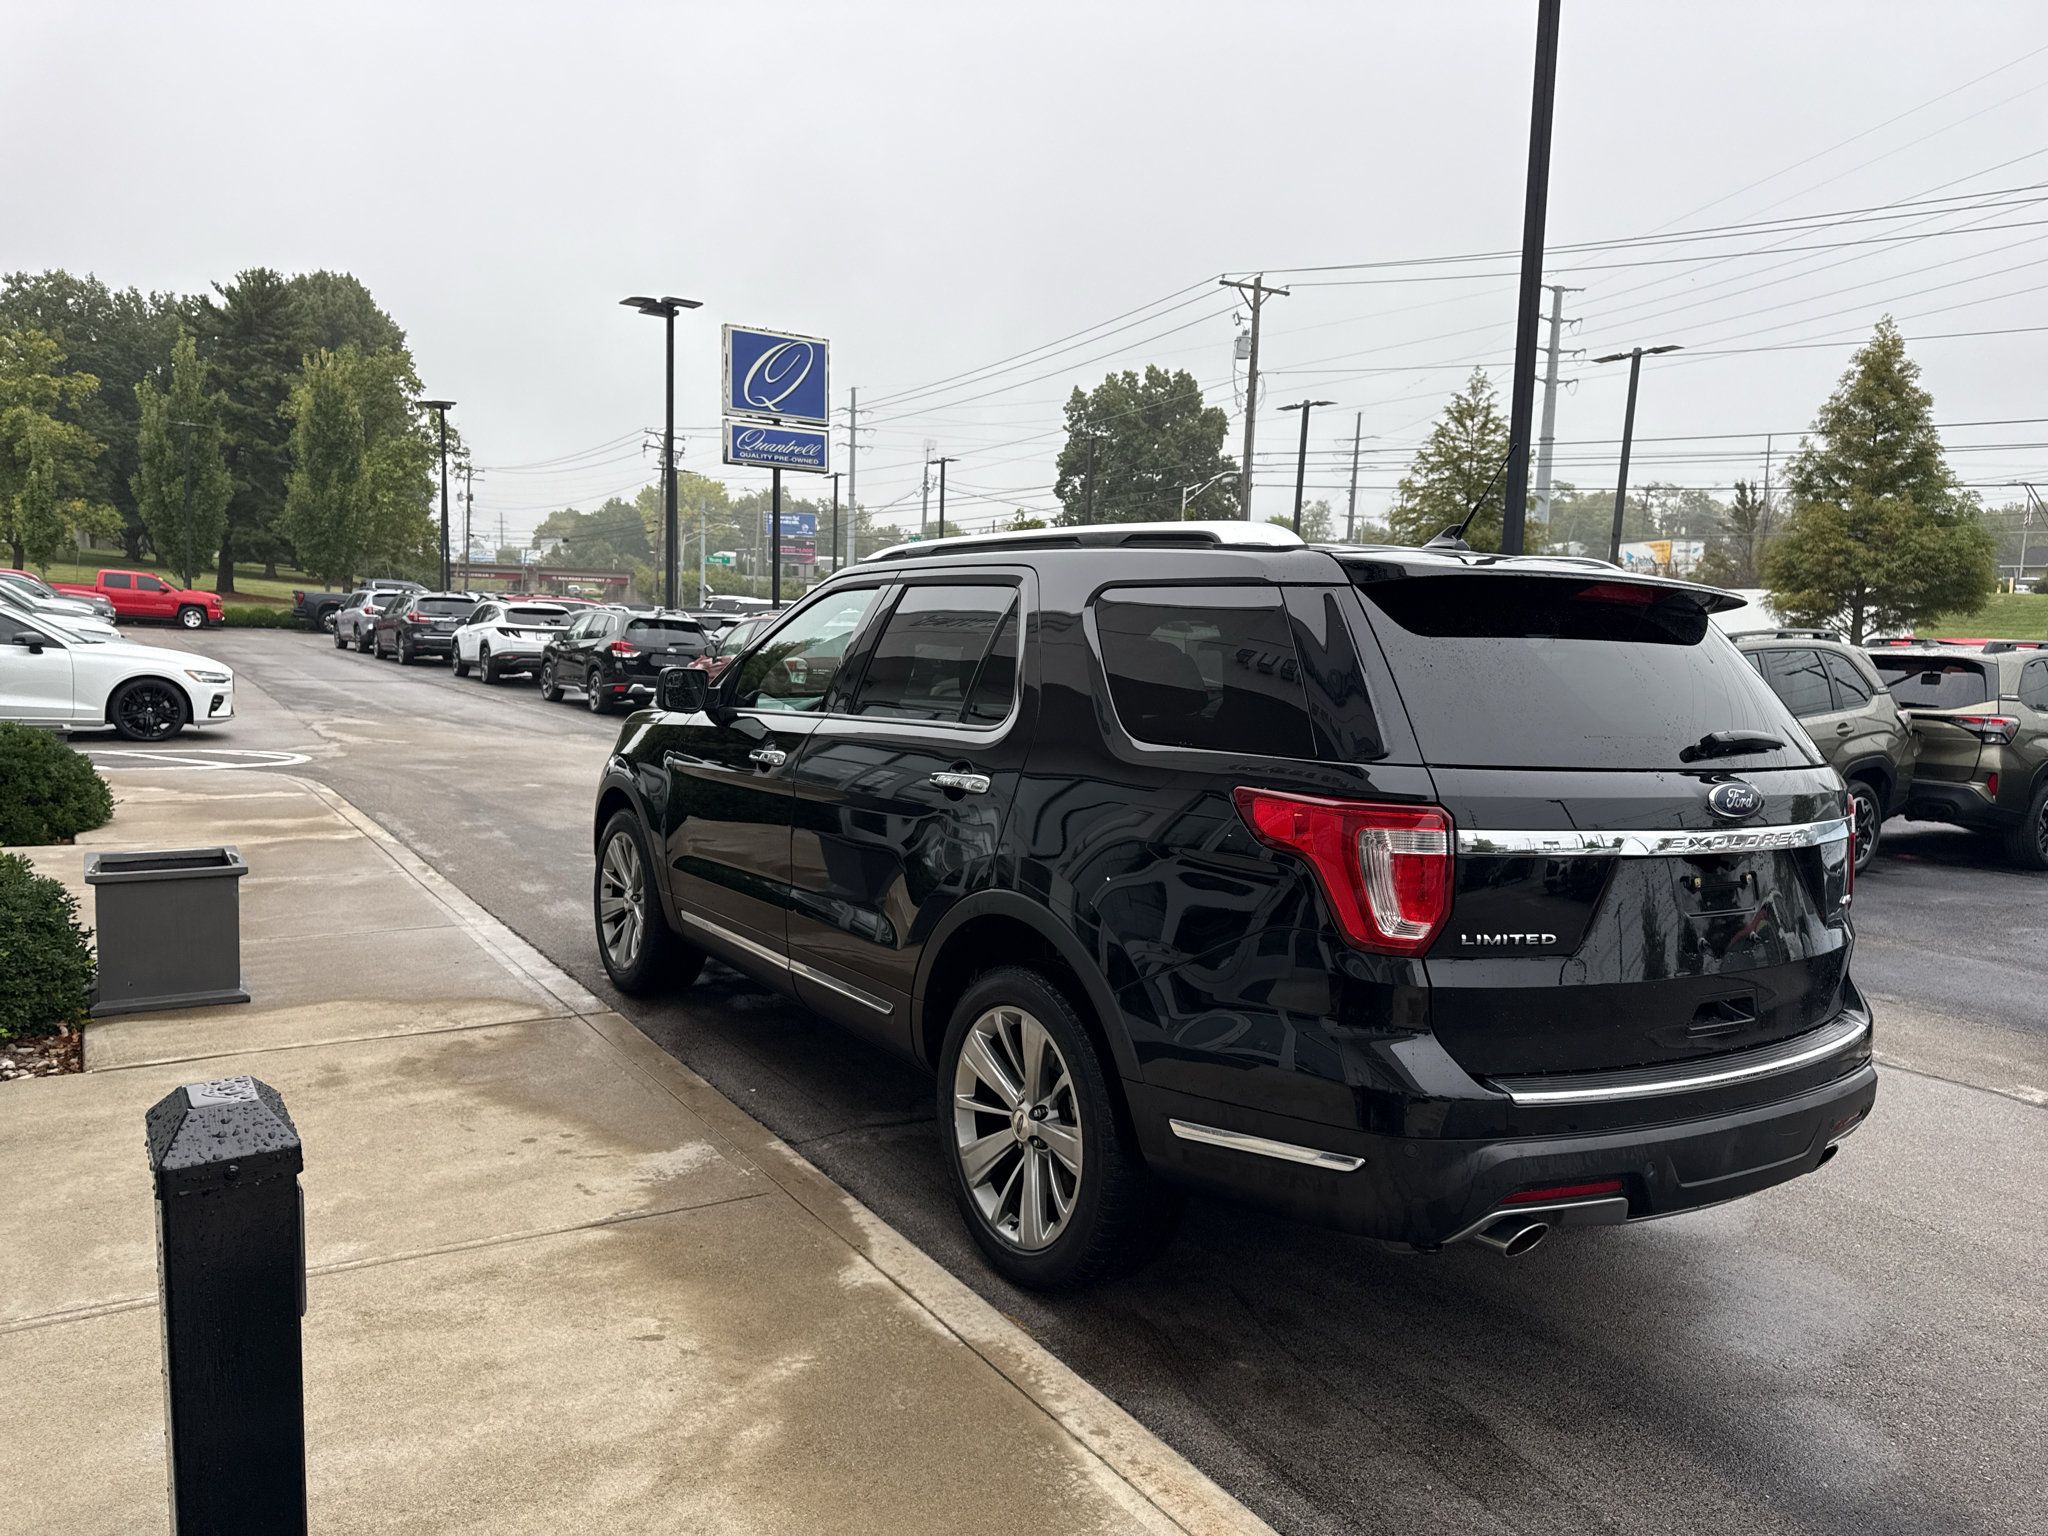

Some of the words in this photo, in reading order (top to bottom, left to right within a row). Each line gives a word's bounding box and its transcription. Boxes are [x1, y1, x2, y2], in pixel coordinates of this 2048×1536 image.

[743, 341, 814, 412] Q
[736, 428, 822, 456] Quantrell
[739, 451, 773, 461] QUALITY
[774, 454, 819, 465] PRE-OWNED
[1726, 788, 1754, 809] Ford
[1668, 831, 1806, 852] EXPLORER
[1461, 933, 1558, 946] LIMITED
